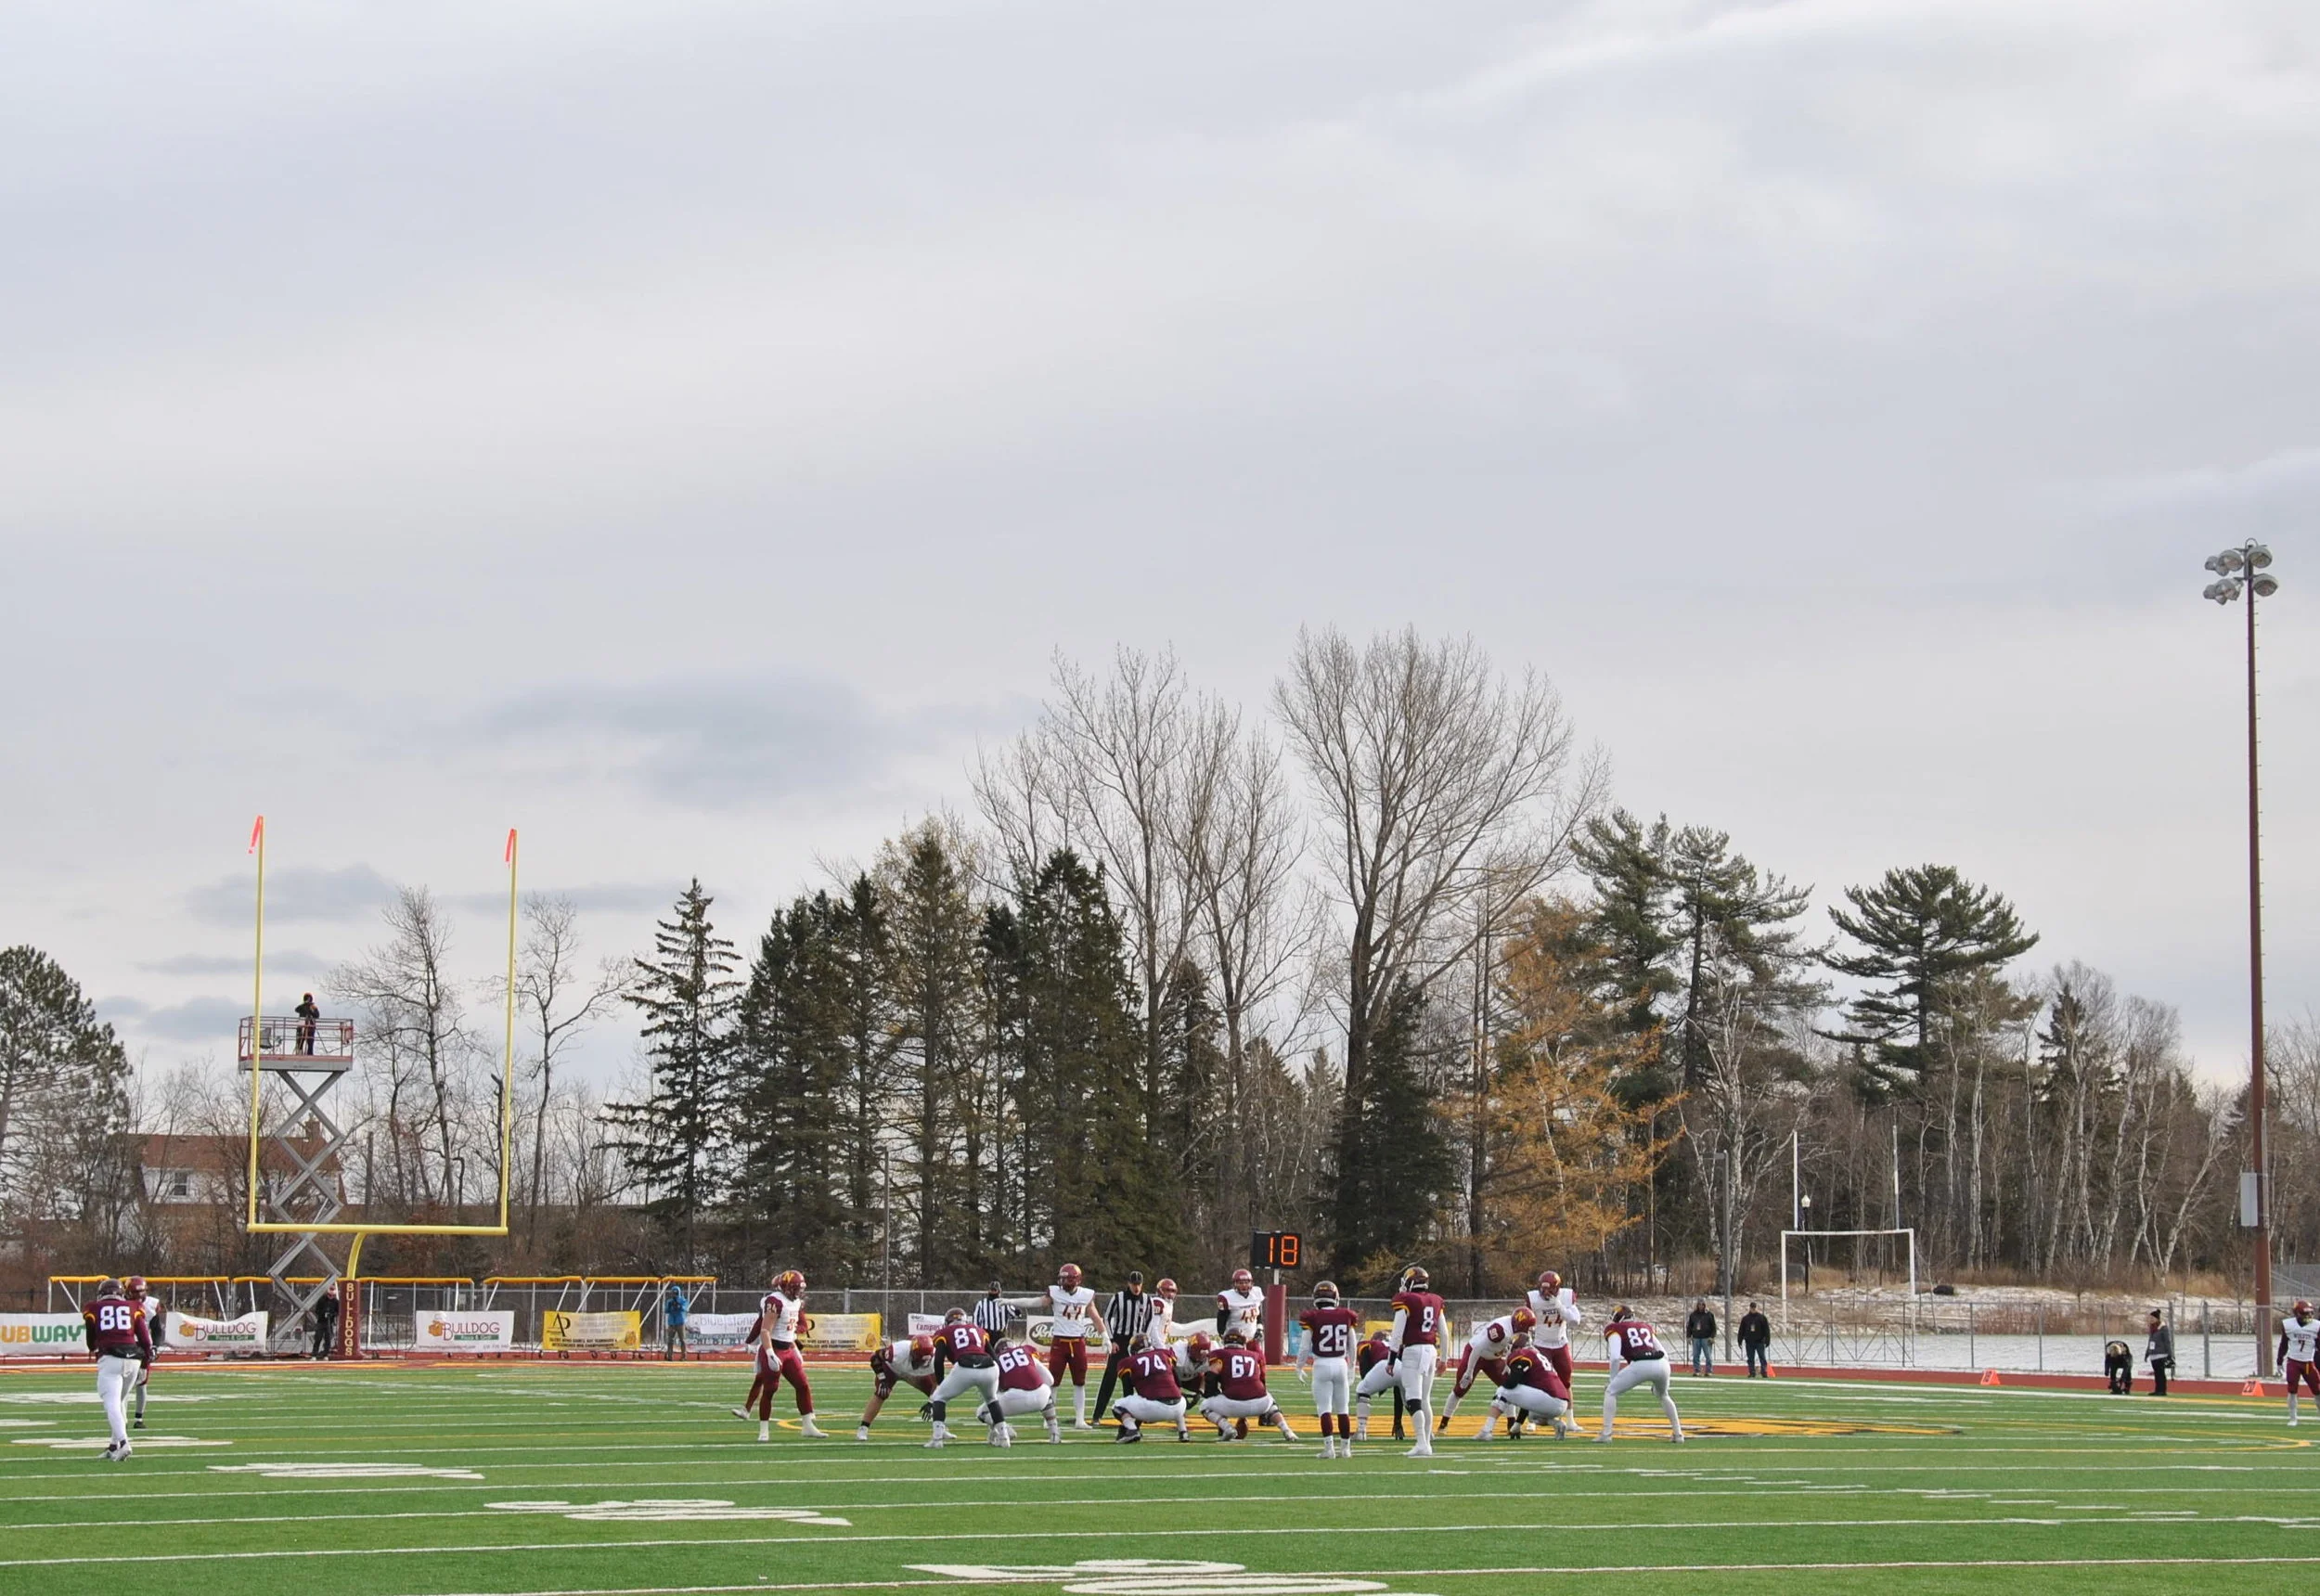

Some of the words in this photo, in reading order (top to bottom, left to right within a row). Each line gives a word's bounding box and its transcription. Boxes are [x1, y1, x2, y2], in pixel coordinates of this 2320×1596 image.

[1269, 1235, 1298, 1266] 18
[99, 1306, 132, 1331] 86
[344, 1282, 354, 1356] BULLDOGS
[1062, 1305, 1082, 1320] 47
[1421, 1306, 1434, 1332] 8
[1543, 1314, 1563, 1328] 44
[0, 1324, 87, 1344] UBWAY
[194, 1322, 257, 1342] BULLDOG
[444, 1321, 501, 1342] BULLDOG
[953, 1327, 982, 1349] 81
[1318, 1324, 1347, 1353] 26
[1627, 1327, 1654, 1348] 82
[2298, 1339, 2305, 1352] 7
[999, 1347, 1030, 1373] 66
[1137, 1355, 1167, 1377] 74
[1231, 1355, 1256, 1379] 67
[900, 1558, 1389, 1595] 20
